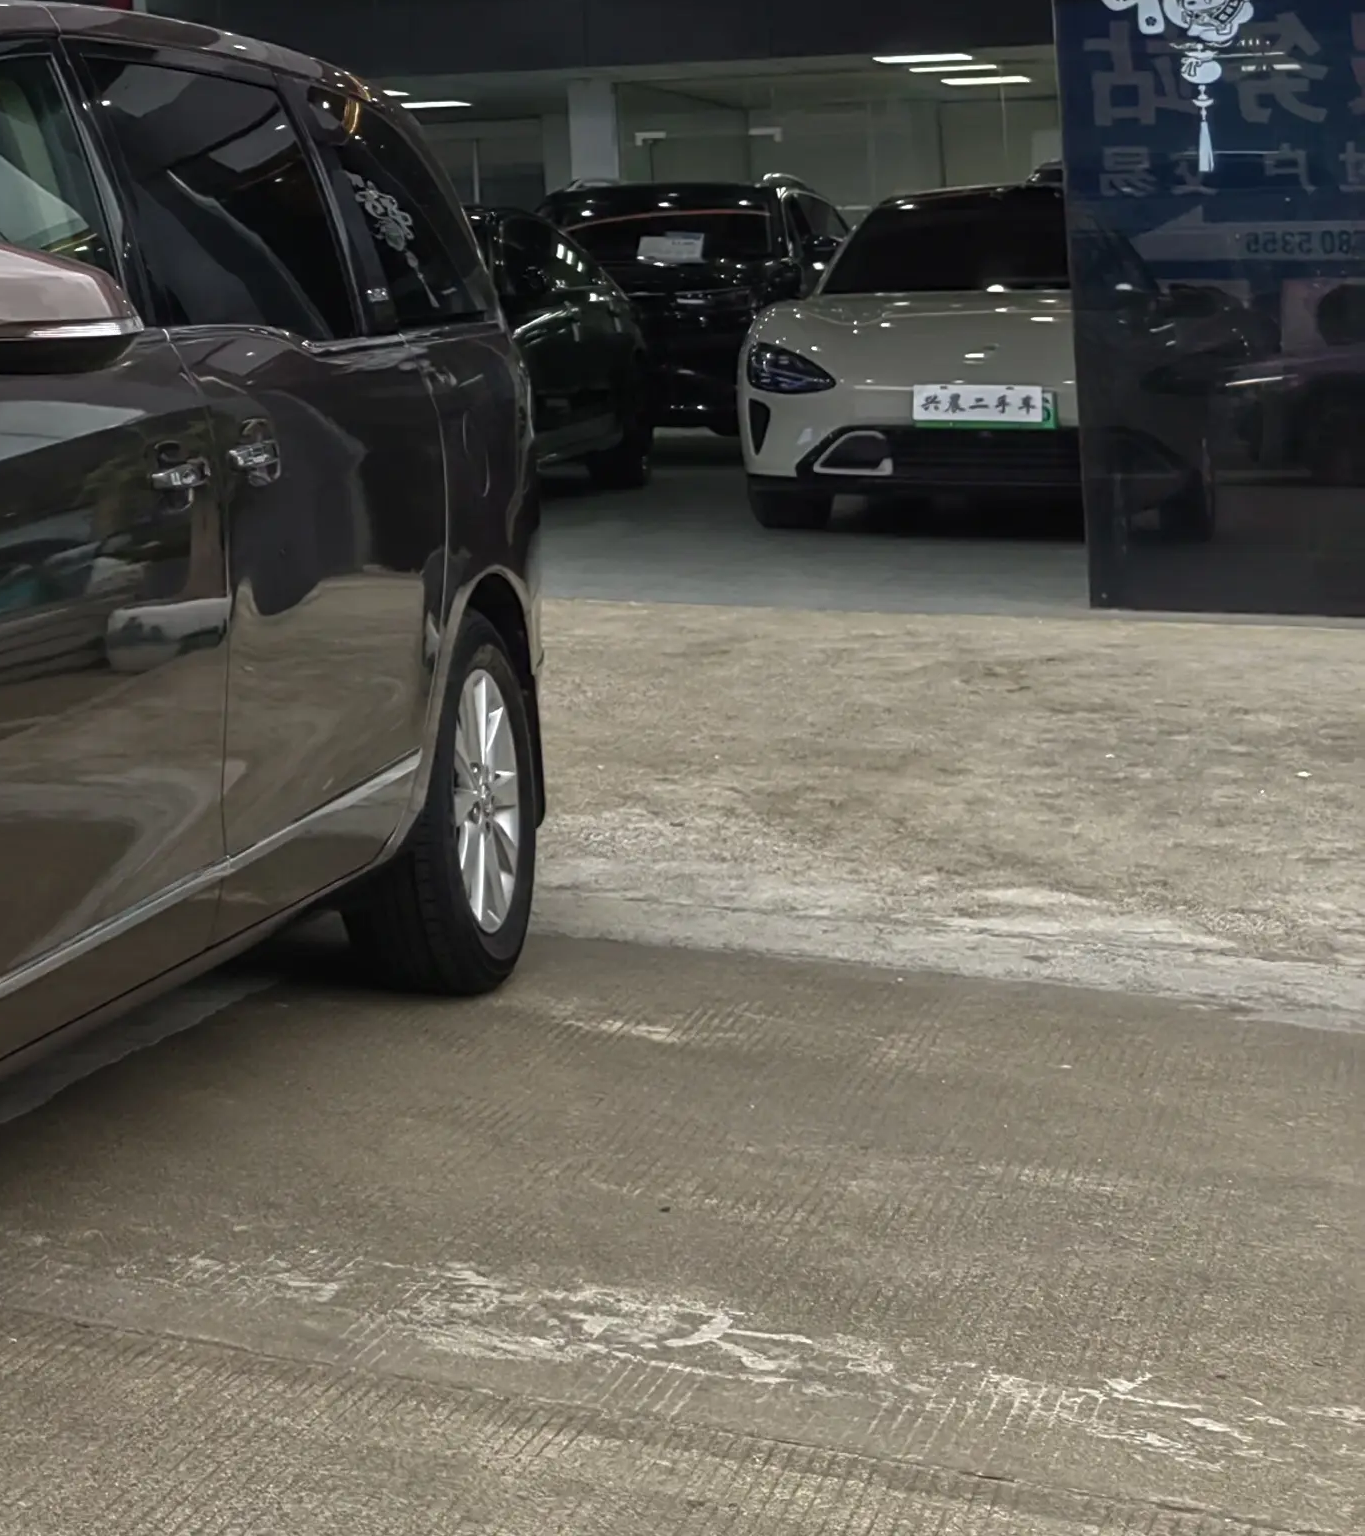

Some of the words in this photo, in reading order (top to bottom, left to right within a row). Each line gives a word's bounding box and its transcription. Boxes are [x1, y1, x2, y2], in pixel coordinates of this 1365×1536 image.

[921, 393, 1037, 415] 兴晨二手车
